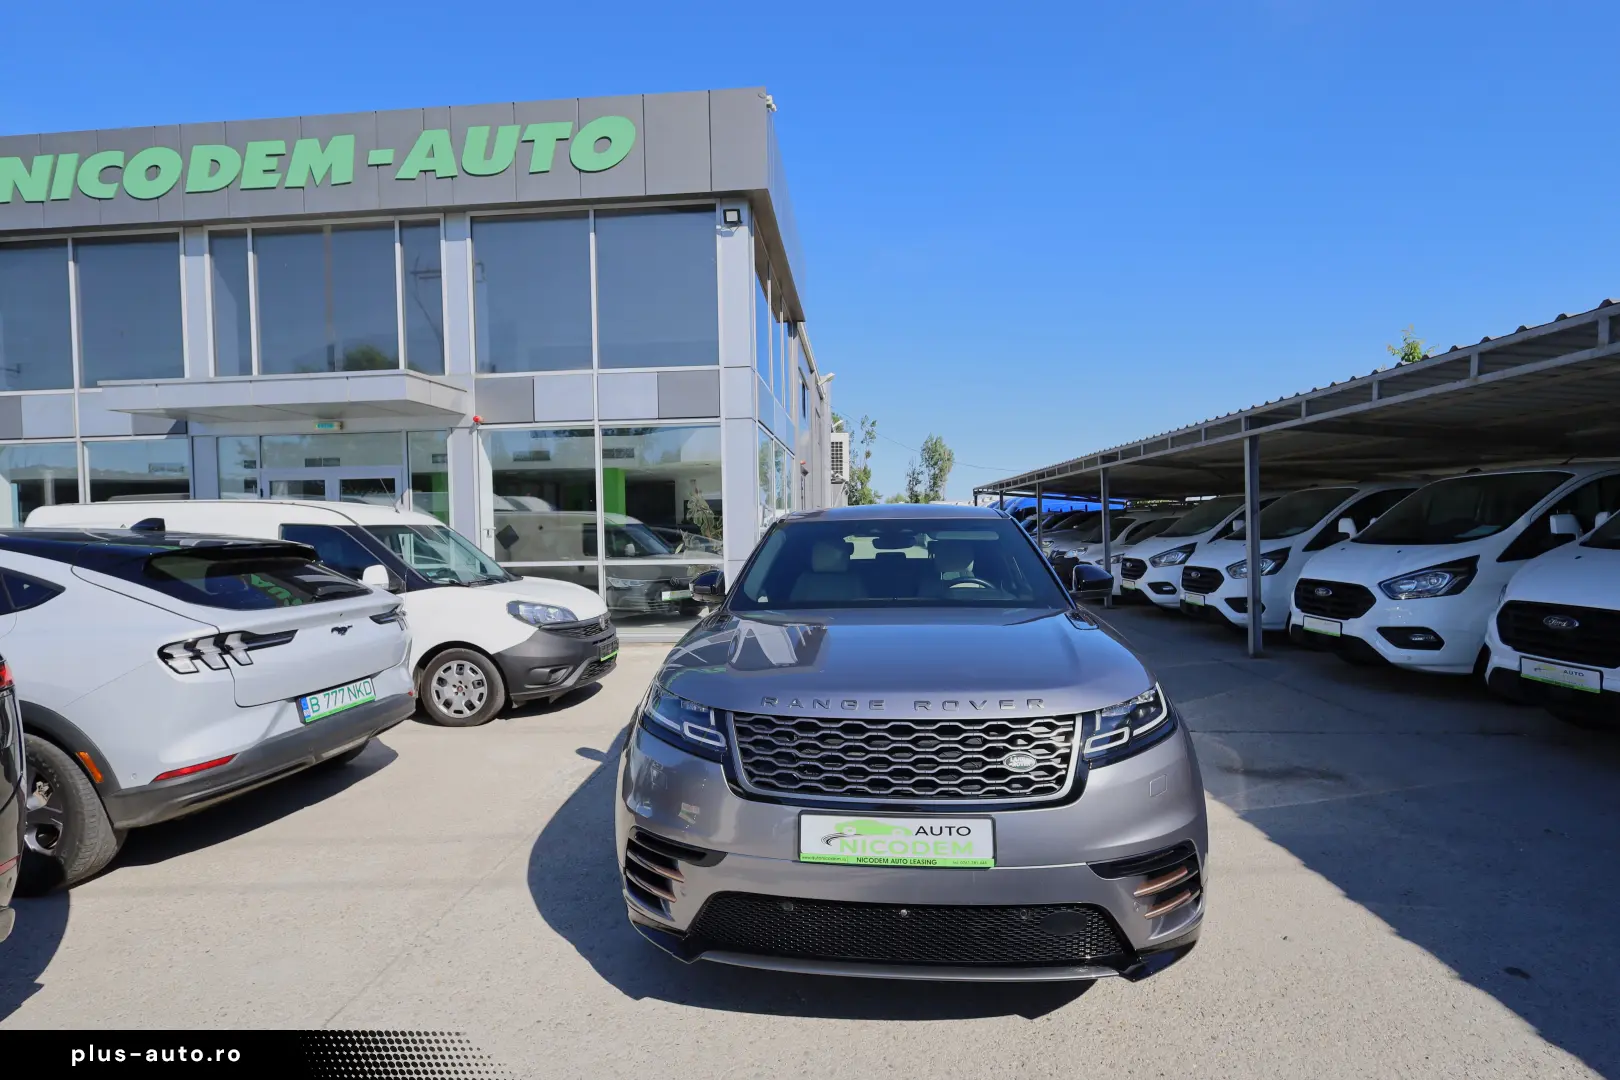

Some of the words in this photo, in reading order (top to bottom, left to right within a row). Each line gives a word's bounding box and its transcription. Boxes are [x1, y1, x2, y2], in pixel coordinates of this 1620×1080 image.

[0, 132, 355, 204] NICODEM
[1563, 669, 1584, 677] AUTO
[309, 696, 321, 713] B
[323, 687, 345, 709] 777
[760, 695, 885, 711] RANGE
[914, 697, 1046, 712] ROVER
[915, 826, 972, 837] AUTO
[839, 839, 973, 856] NICODEM
[856, 856, 890, 865] NICODEM
[909, 858, 938, 866] LEASING
